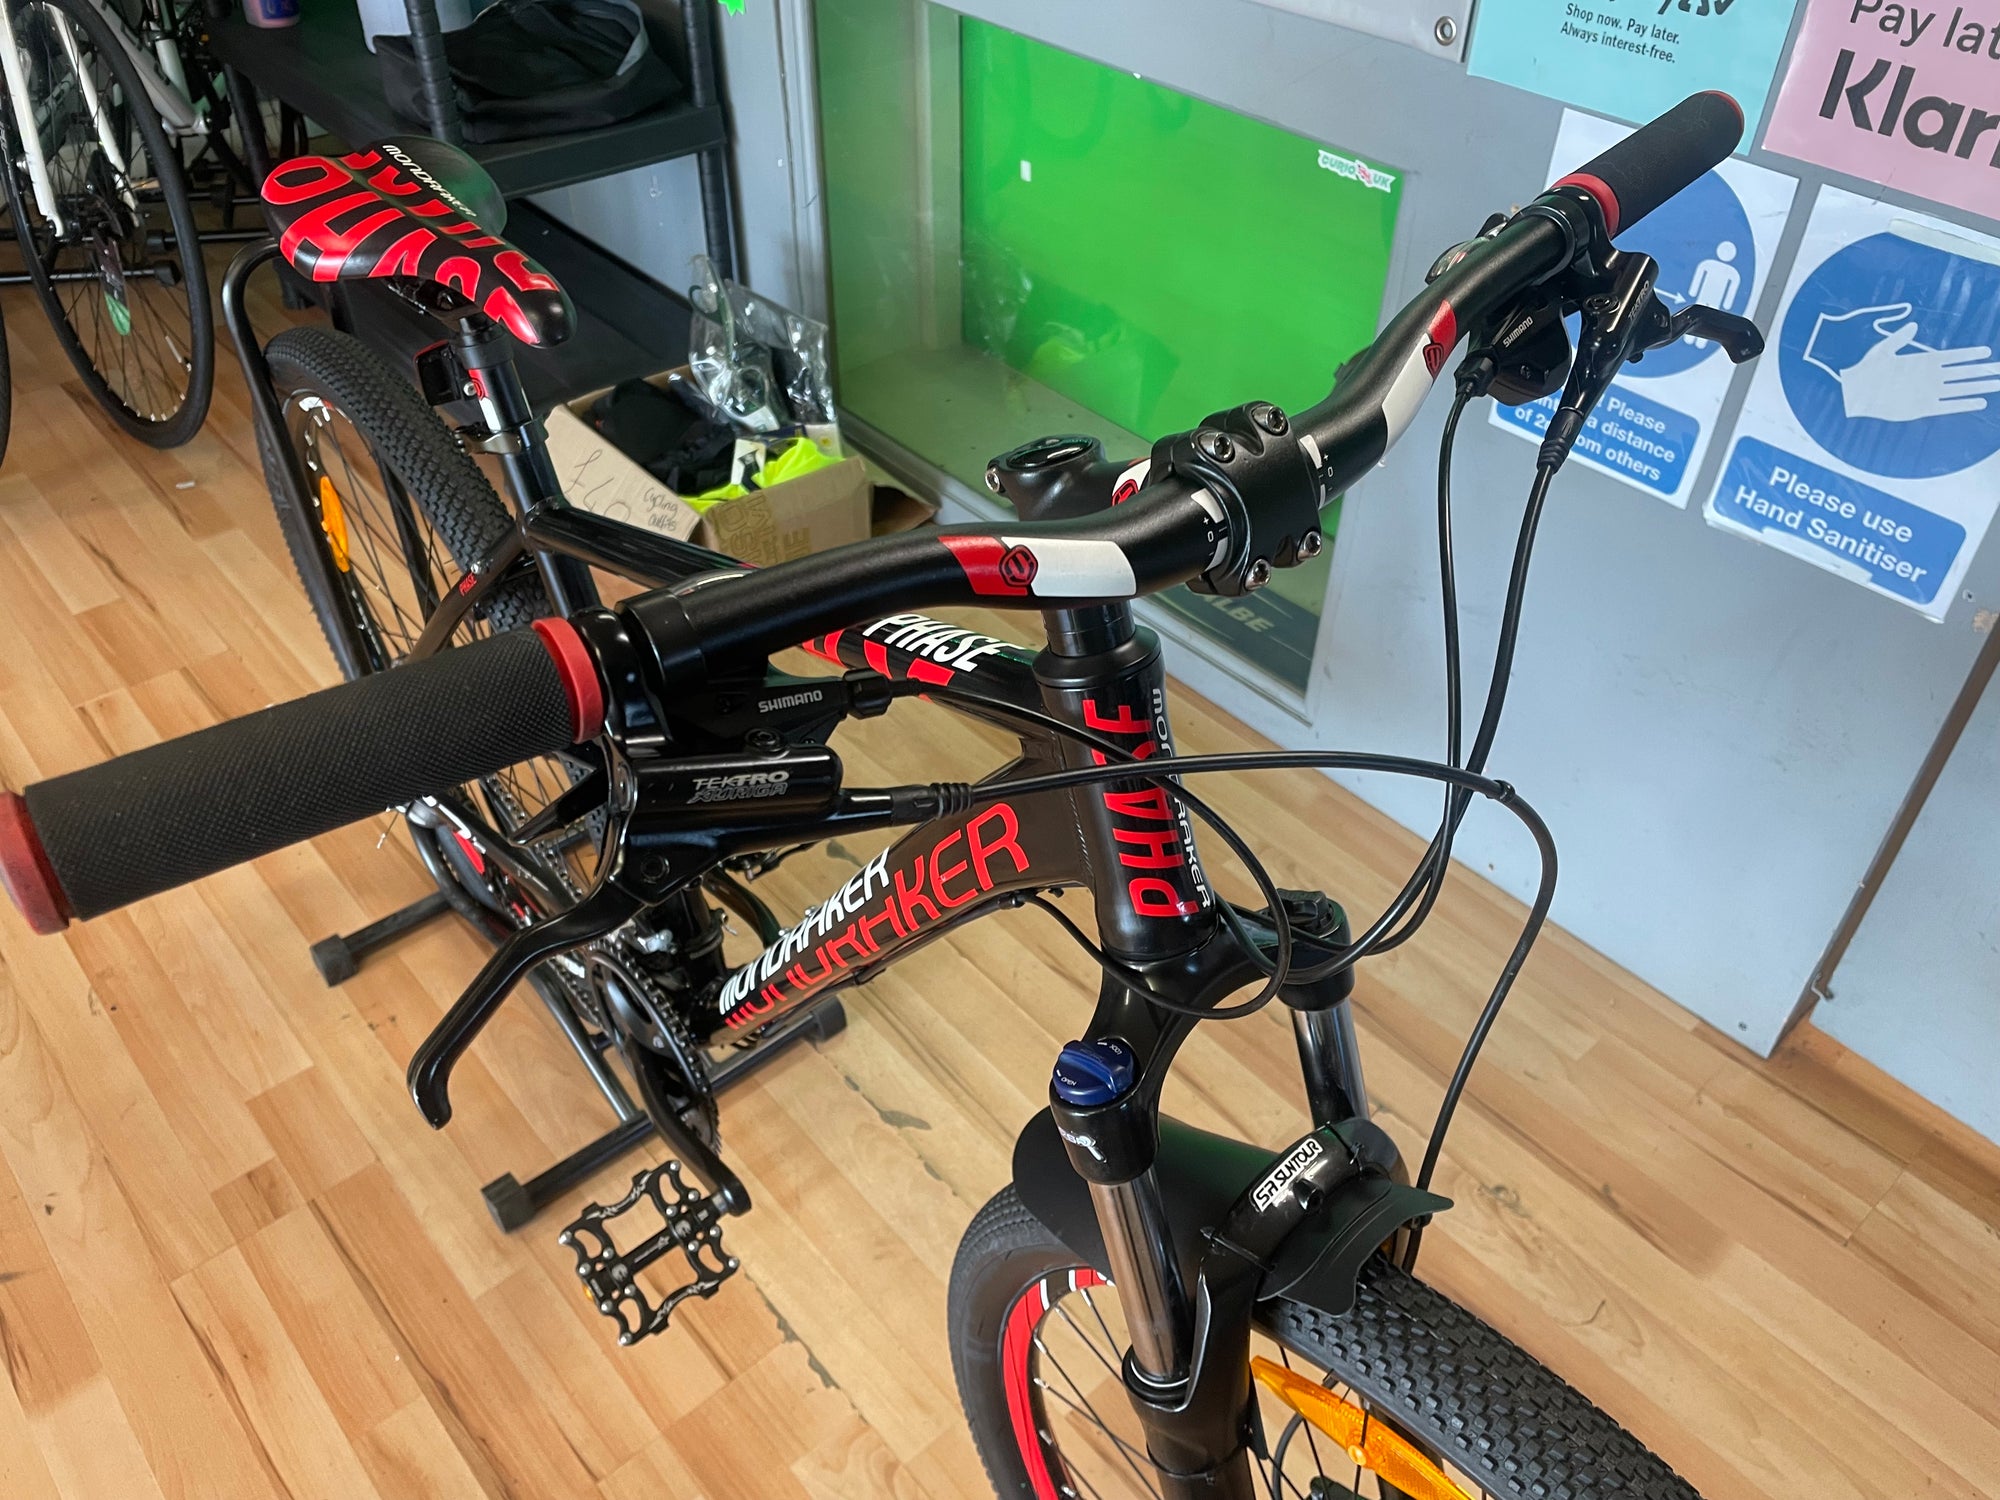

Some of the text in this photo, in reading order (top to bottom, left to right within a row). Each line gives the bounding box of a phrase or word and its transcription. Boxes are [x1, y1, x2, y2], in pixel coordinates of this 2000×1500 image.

[1560, 22, 1677, 63] Always interest-free.
[1566, 3, 1593, 23] Shop
[1597, 14, 1623, 29] now.
[1627, 18, 1648, 38] Pay
[1650, 24, 1681, 45] later.
[1850, 0, 1936, 47] Pay
[1502, 315, 1534, 348] SHIMANO
[1608, 396, 1667, 434] Please
[1514, 407, 1534, 423] of
[1605, 446, 1662, 482] others
[1601, 421, 1676, 464] distance
[1769, 466, 1914, 543] Please use
[1734, 485, 1928, 583] Hand Sanitiser
[862, 613, 1027, 673] PHASE
[758, 690, 823, 713] SHIMANO
[692, 770, 790, 791] TEKTRO
[1274, 1140, 1320, 1188] SUNTOUR
